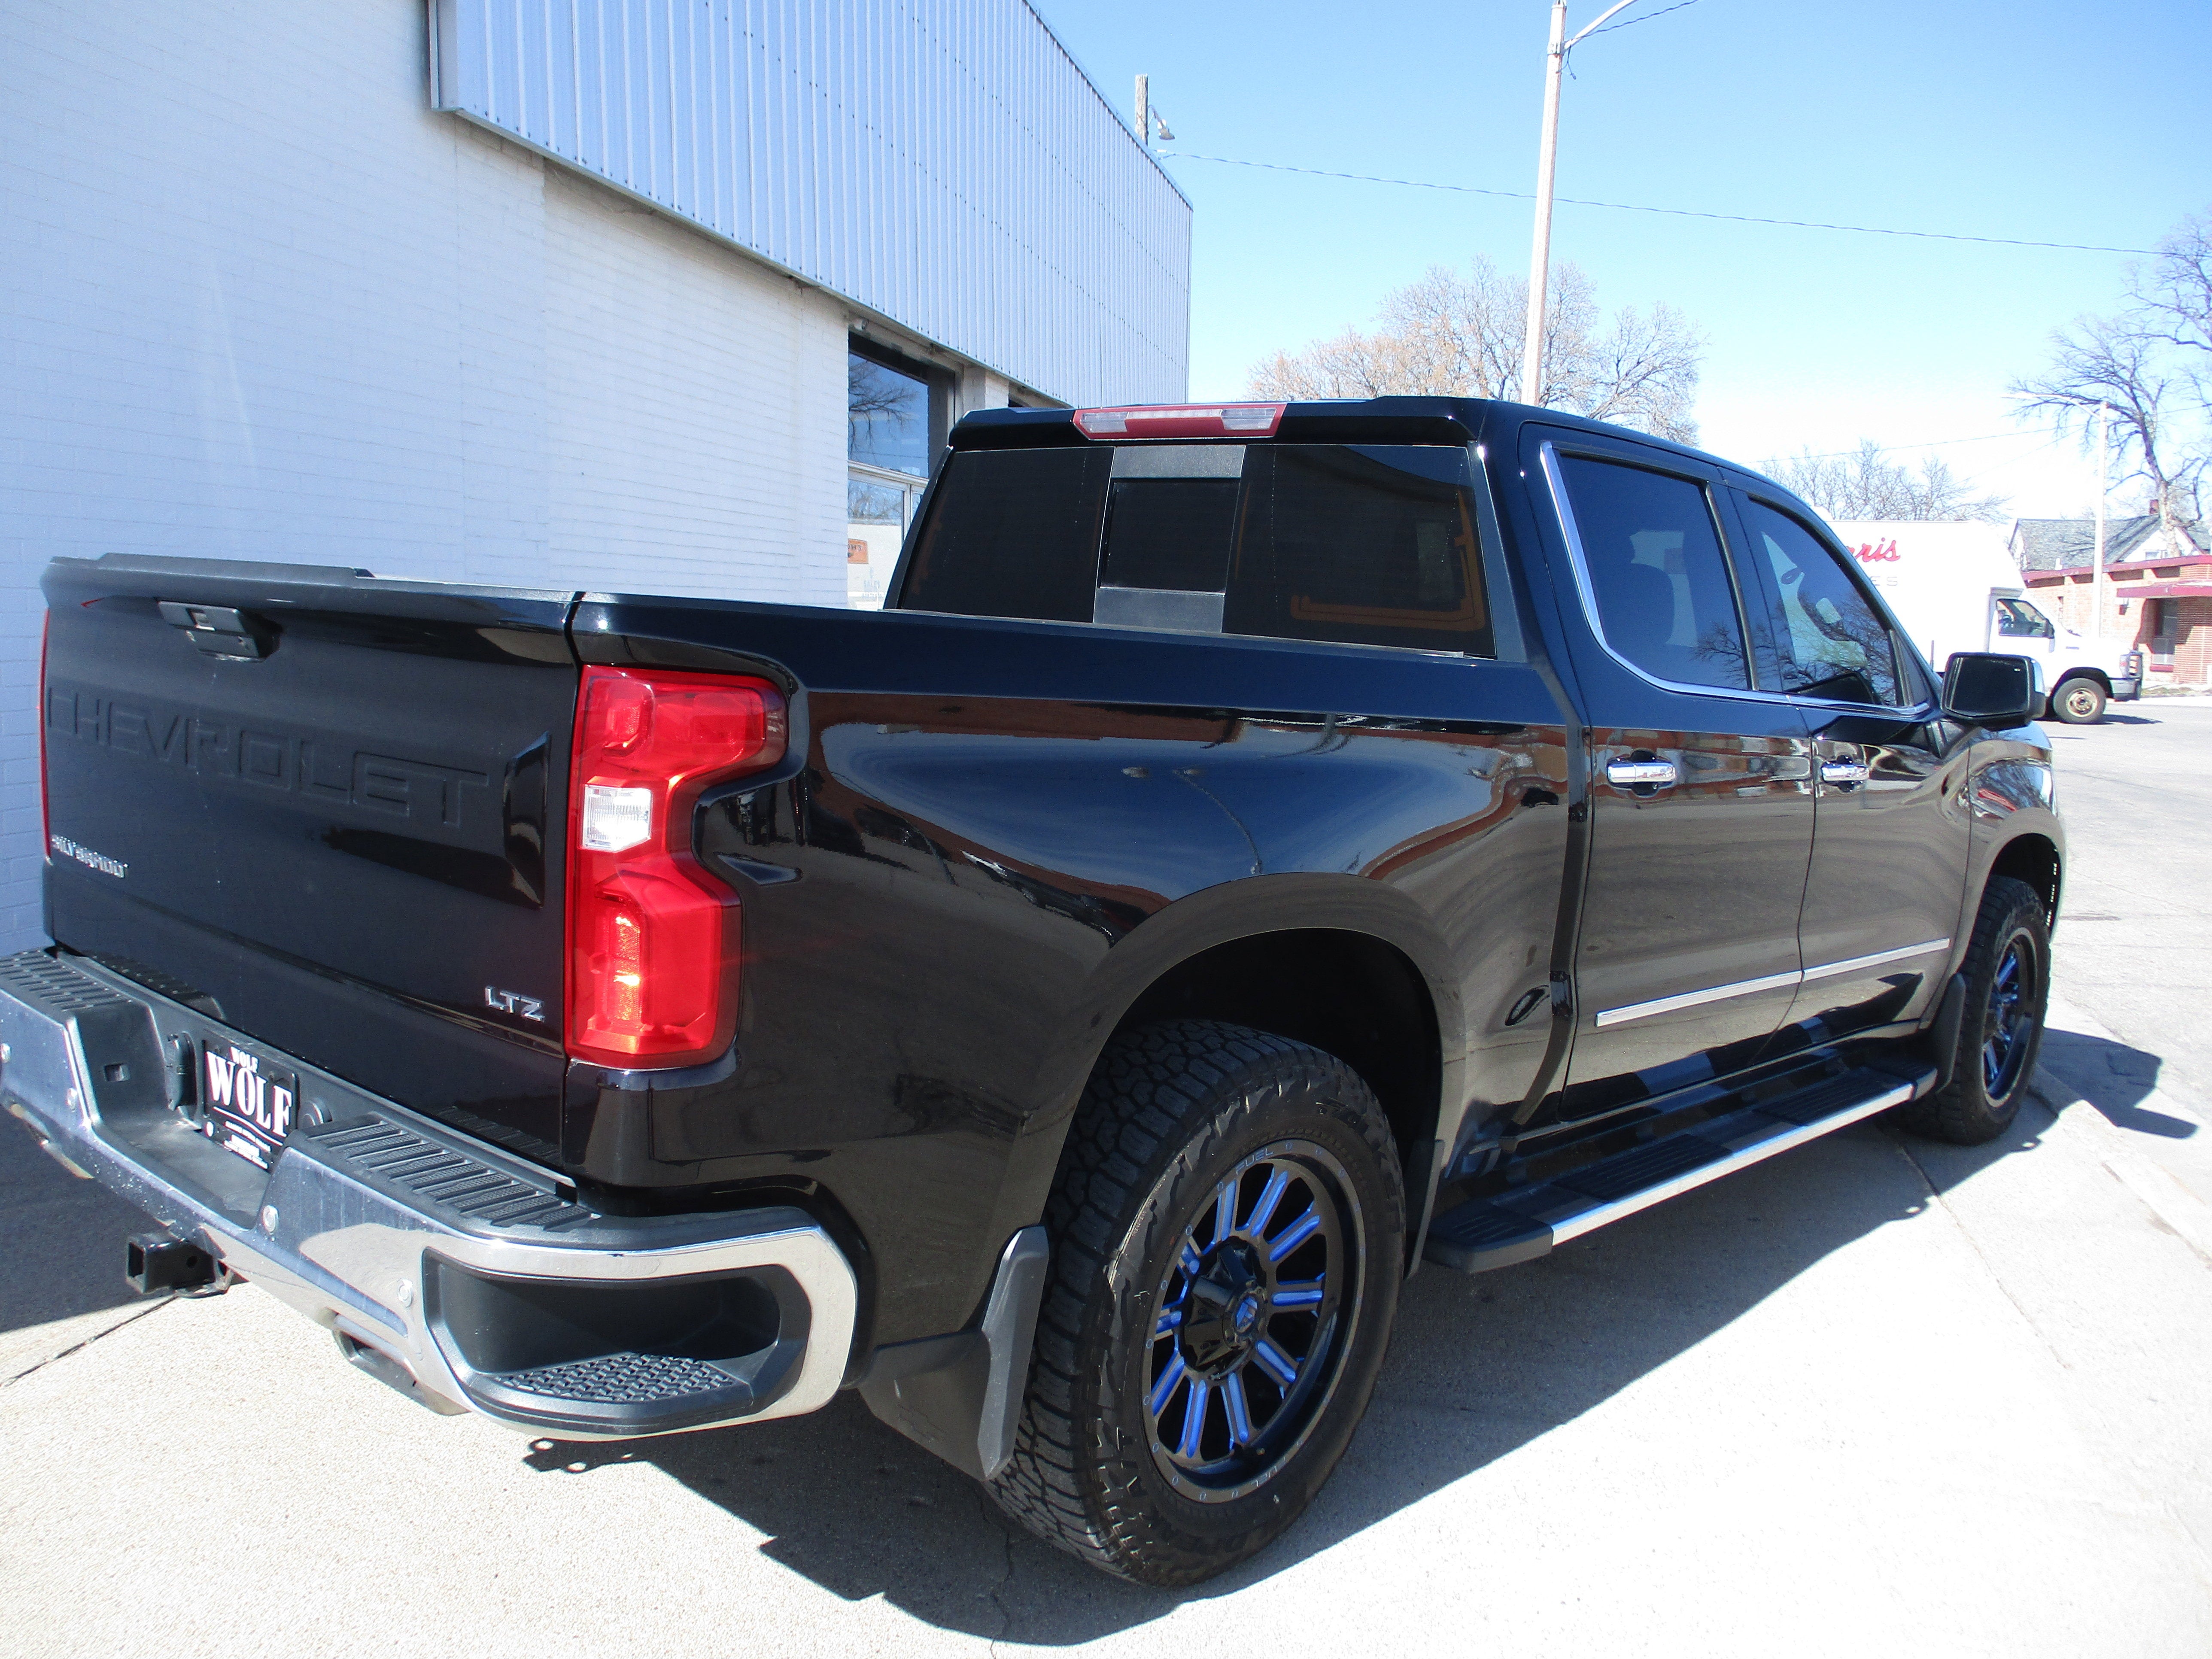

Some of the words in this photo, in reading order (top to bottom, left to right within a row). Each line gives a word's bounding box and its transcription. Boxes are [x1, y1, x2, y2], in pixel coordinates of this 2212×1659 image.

[48, 686, 490, 827] CHEVROLET
[485, 985, 545, 1022] LTZ
[230, 1046, 258, 1073] WOLF
[205, 1051, 293, 1137] WOLF
[1236, 1148, 1273, 1175] FUEL
